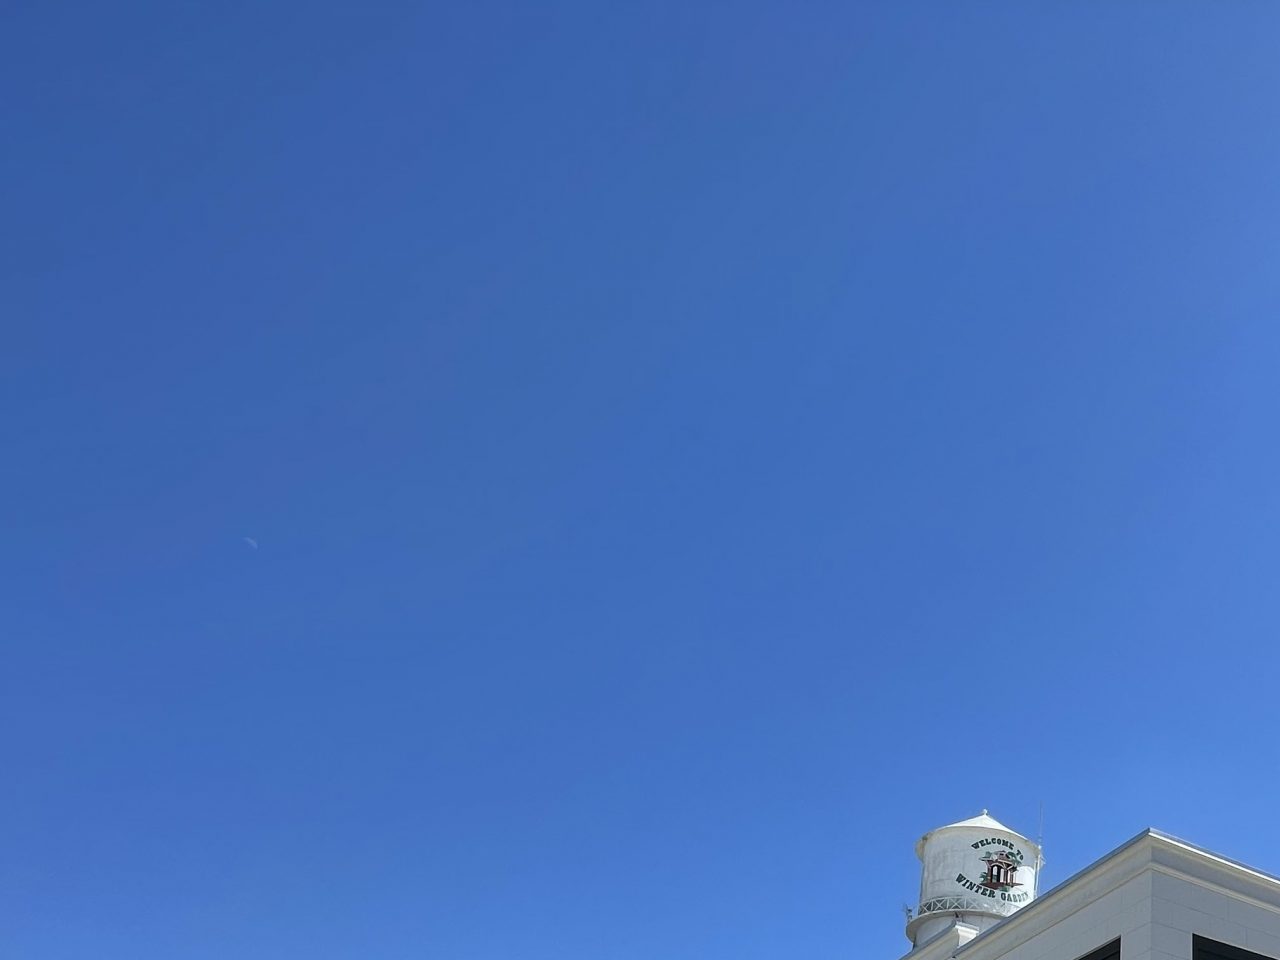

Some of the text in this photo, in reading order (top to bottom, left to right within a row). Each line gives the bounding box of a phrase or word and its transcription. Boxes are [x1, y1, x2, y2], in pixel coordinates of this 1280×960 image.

[971, 838, 1024, 861] WELCOME TO
[955, 873, 996, 898] WINTER
